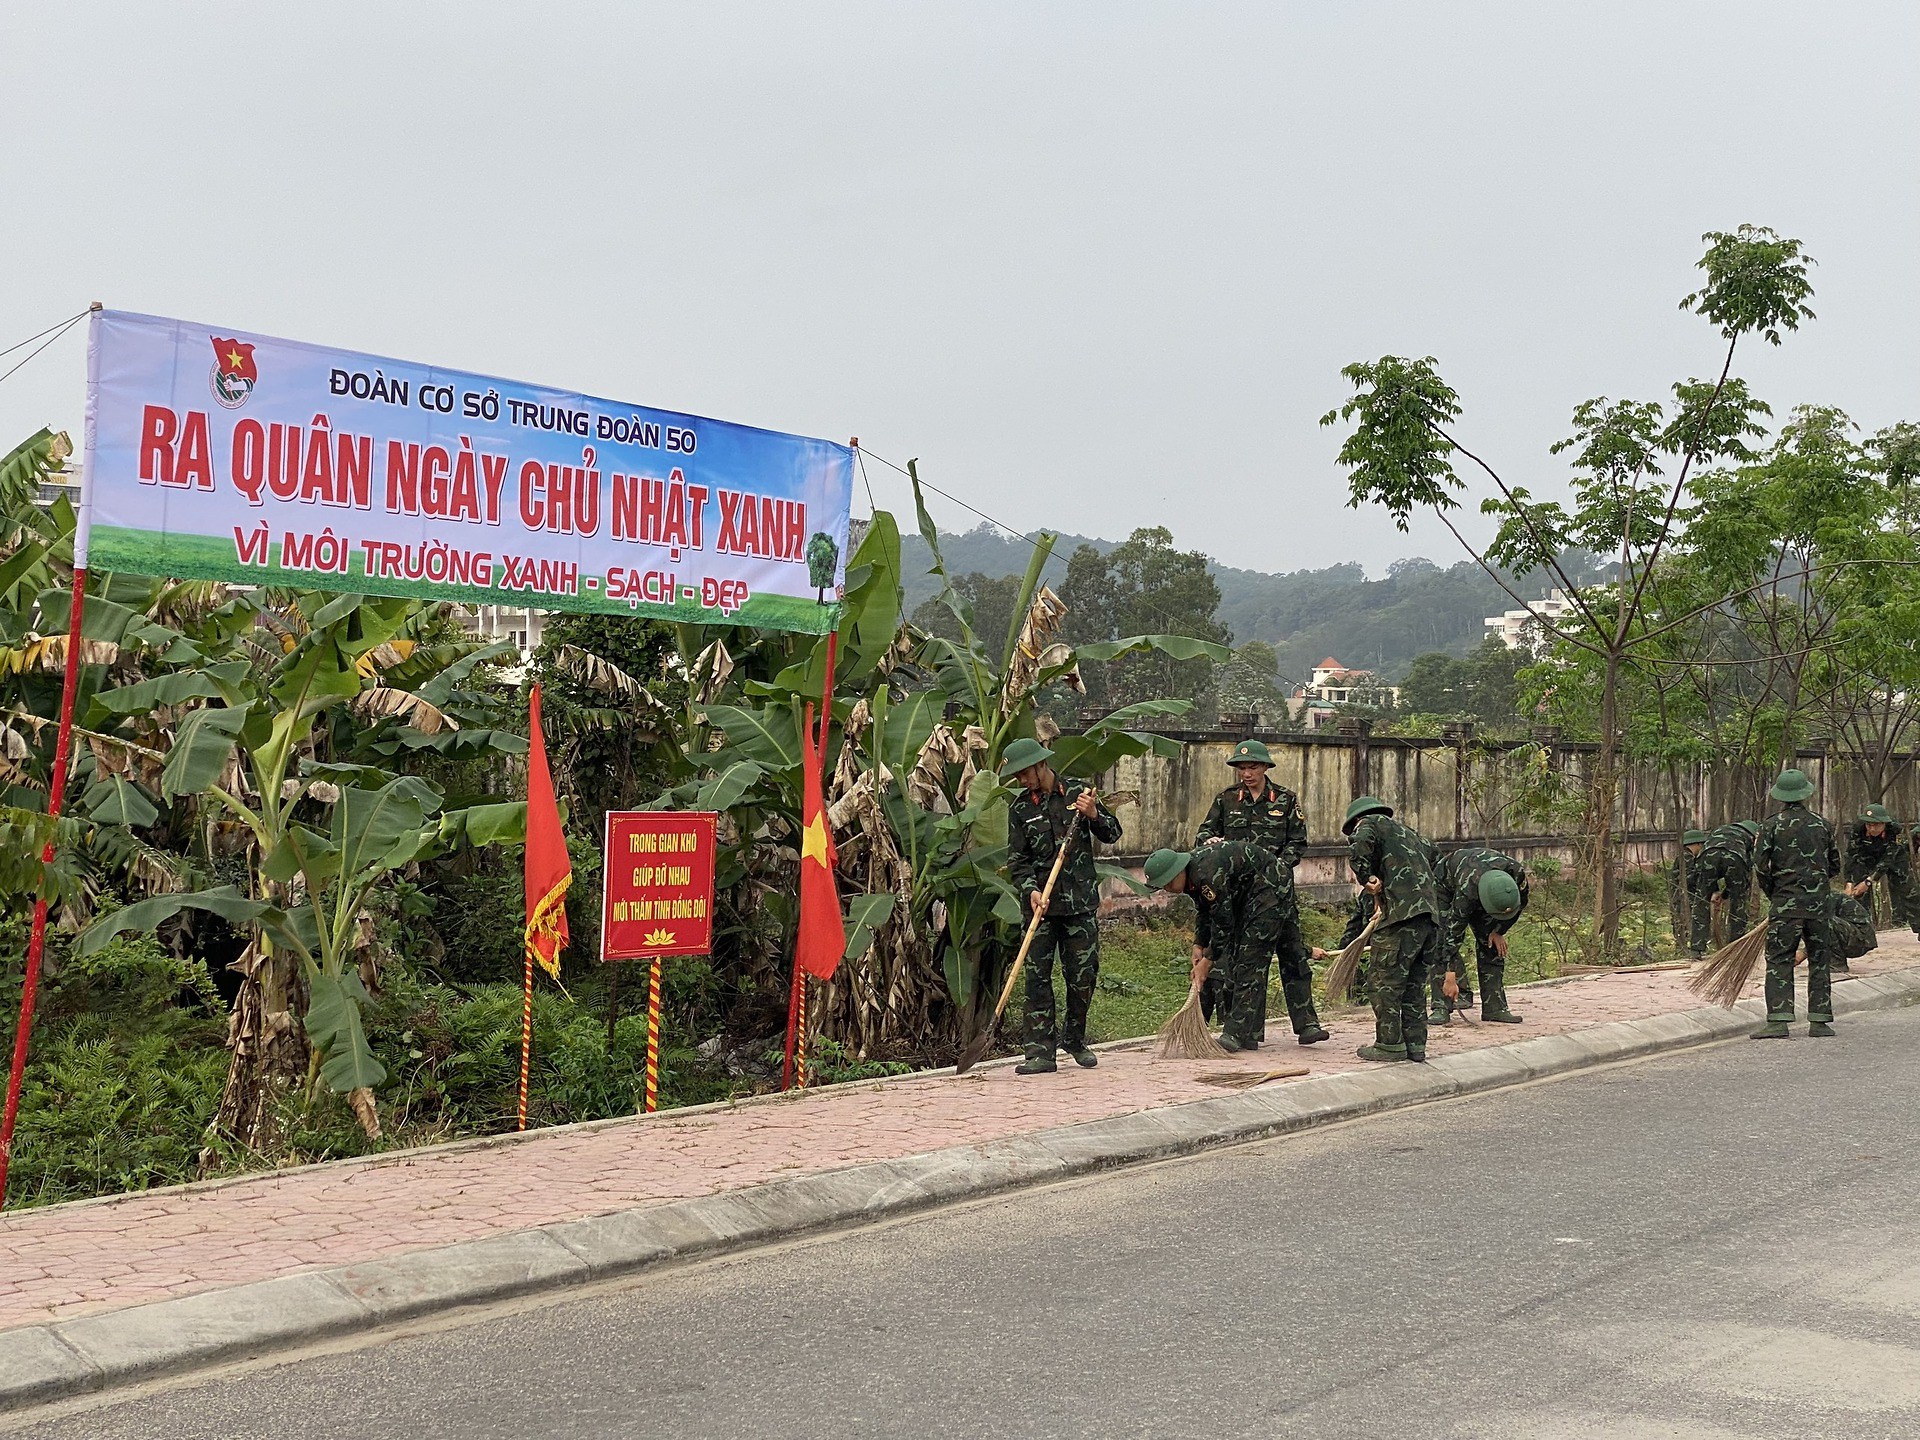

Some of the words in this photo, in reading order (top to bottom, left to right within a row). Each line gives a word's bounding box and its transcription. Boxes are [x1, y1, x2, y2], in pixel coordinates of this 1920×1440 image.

[329, 368, 409, 406] ĐOÀN
[418, 385, 454, 413] CƠ
[463, 389, 499, 421] SỞ
[507, 399, 590, 437] TRUNG
[597, 415, 659, 448] ĐOÀN
[667, 428, 696, 454] 50
[138, 404, 215, 491] RA
[230, 413, 374, 510] QUÂN
[385, 436, 509, 526] NGÀY
[519, 447, 601, 538] CHỦ
[611, 469, 709, 562] NHẬT
[716, 489, 807, 563] XANH
[233, 519, 270, 565] VÌ
[282, 527, 349, 572] MÔI
[360, 538, 492, 586] TRƯỜNG
[500, 554, 578, 594] XANH
[587, 577, 598, 588] -
[606, 567, 676, 608] SẠCH
[684, 588, 695, 598] -
[701, 576, 749, 617] ĐẸP
[629, 833, 657, 853] TRONG
[658, 833, 679, 853] GIAN
[680, 828, 697, 853] KHÓ
[632, 862, 654, 887] GIÚP
[655, 862, 667, 886] ĐỠ
[668, 866, 690, 886] NHAU
[613, 897, 628, 922] MỚI
[630, 893, 652, 921] THẤM
[654, 896, 671, 920] TÌNH
[672, 892, 693, 919] ĐỒNG
[693, 894, 707, 922] ĐỘI
